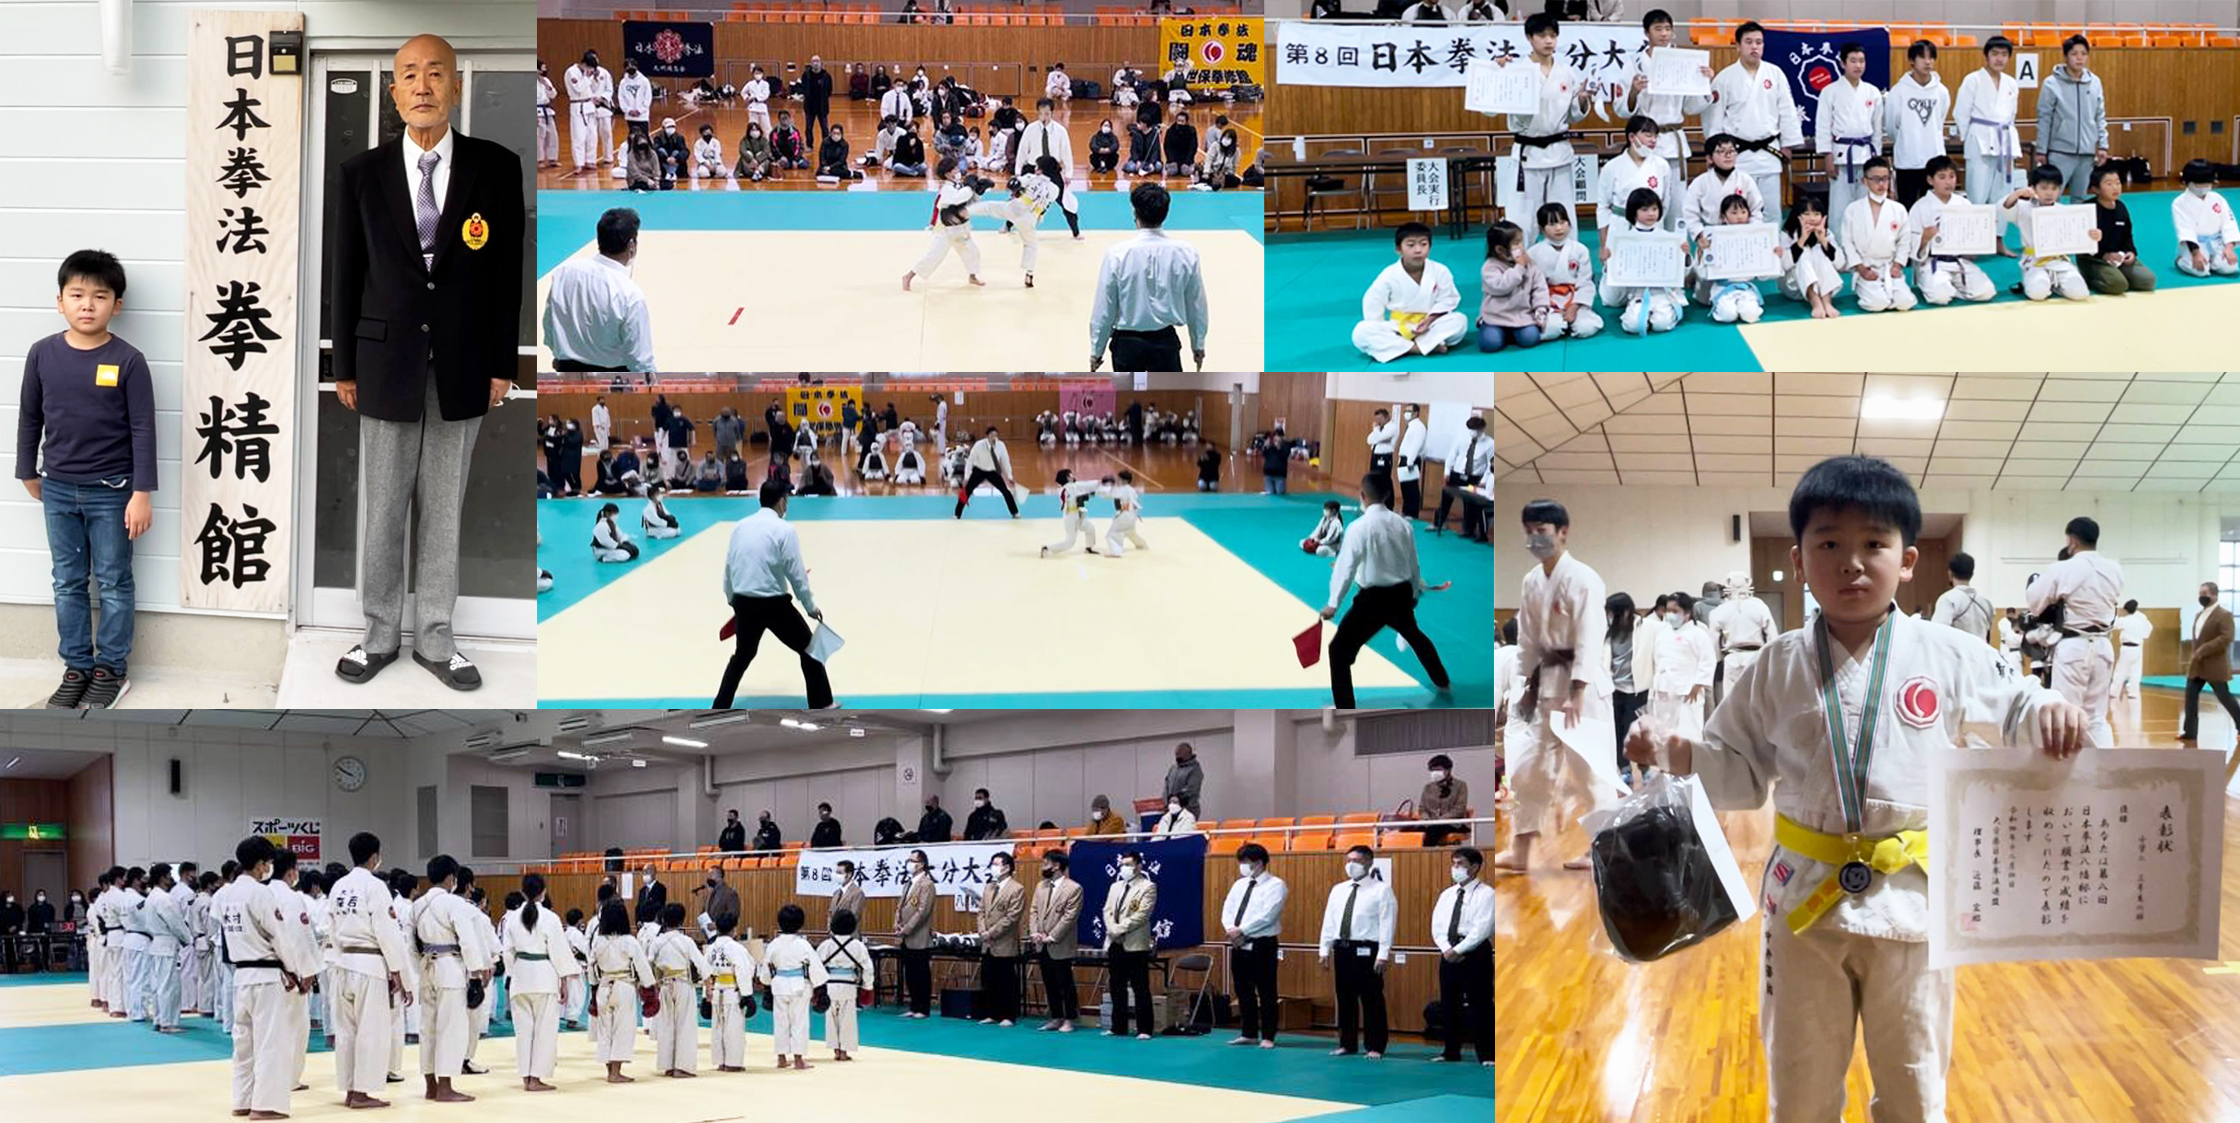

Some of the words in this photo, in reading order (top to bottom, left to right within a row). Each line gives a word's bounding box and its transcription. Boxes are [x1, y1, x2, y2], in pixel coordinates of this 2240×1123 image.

[1180, 23, 1249, 37] 日本拳法
[1285, 43, 1359, 66] 第8回
[1371, 37, 1648, 75] 日本拳法分大
[2019, 60, 2035, 81] A
[1415, 162, 1428, 196] 委員長
[1428, 161, 1440, 207] 大会実行
[1575, 156, 1587, 202] 大会顧問
[193, 34, 282, 589] 日本拳法拳精館
[252, 818, 321, 834] スポーツくじ
[2023, 806, 2034, 842] します
[2157, 804, 2173, 853] 表彰状
